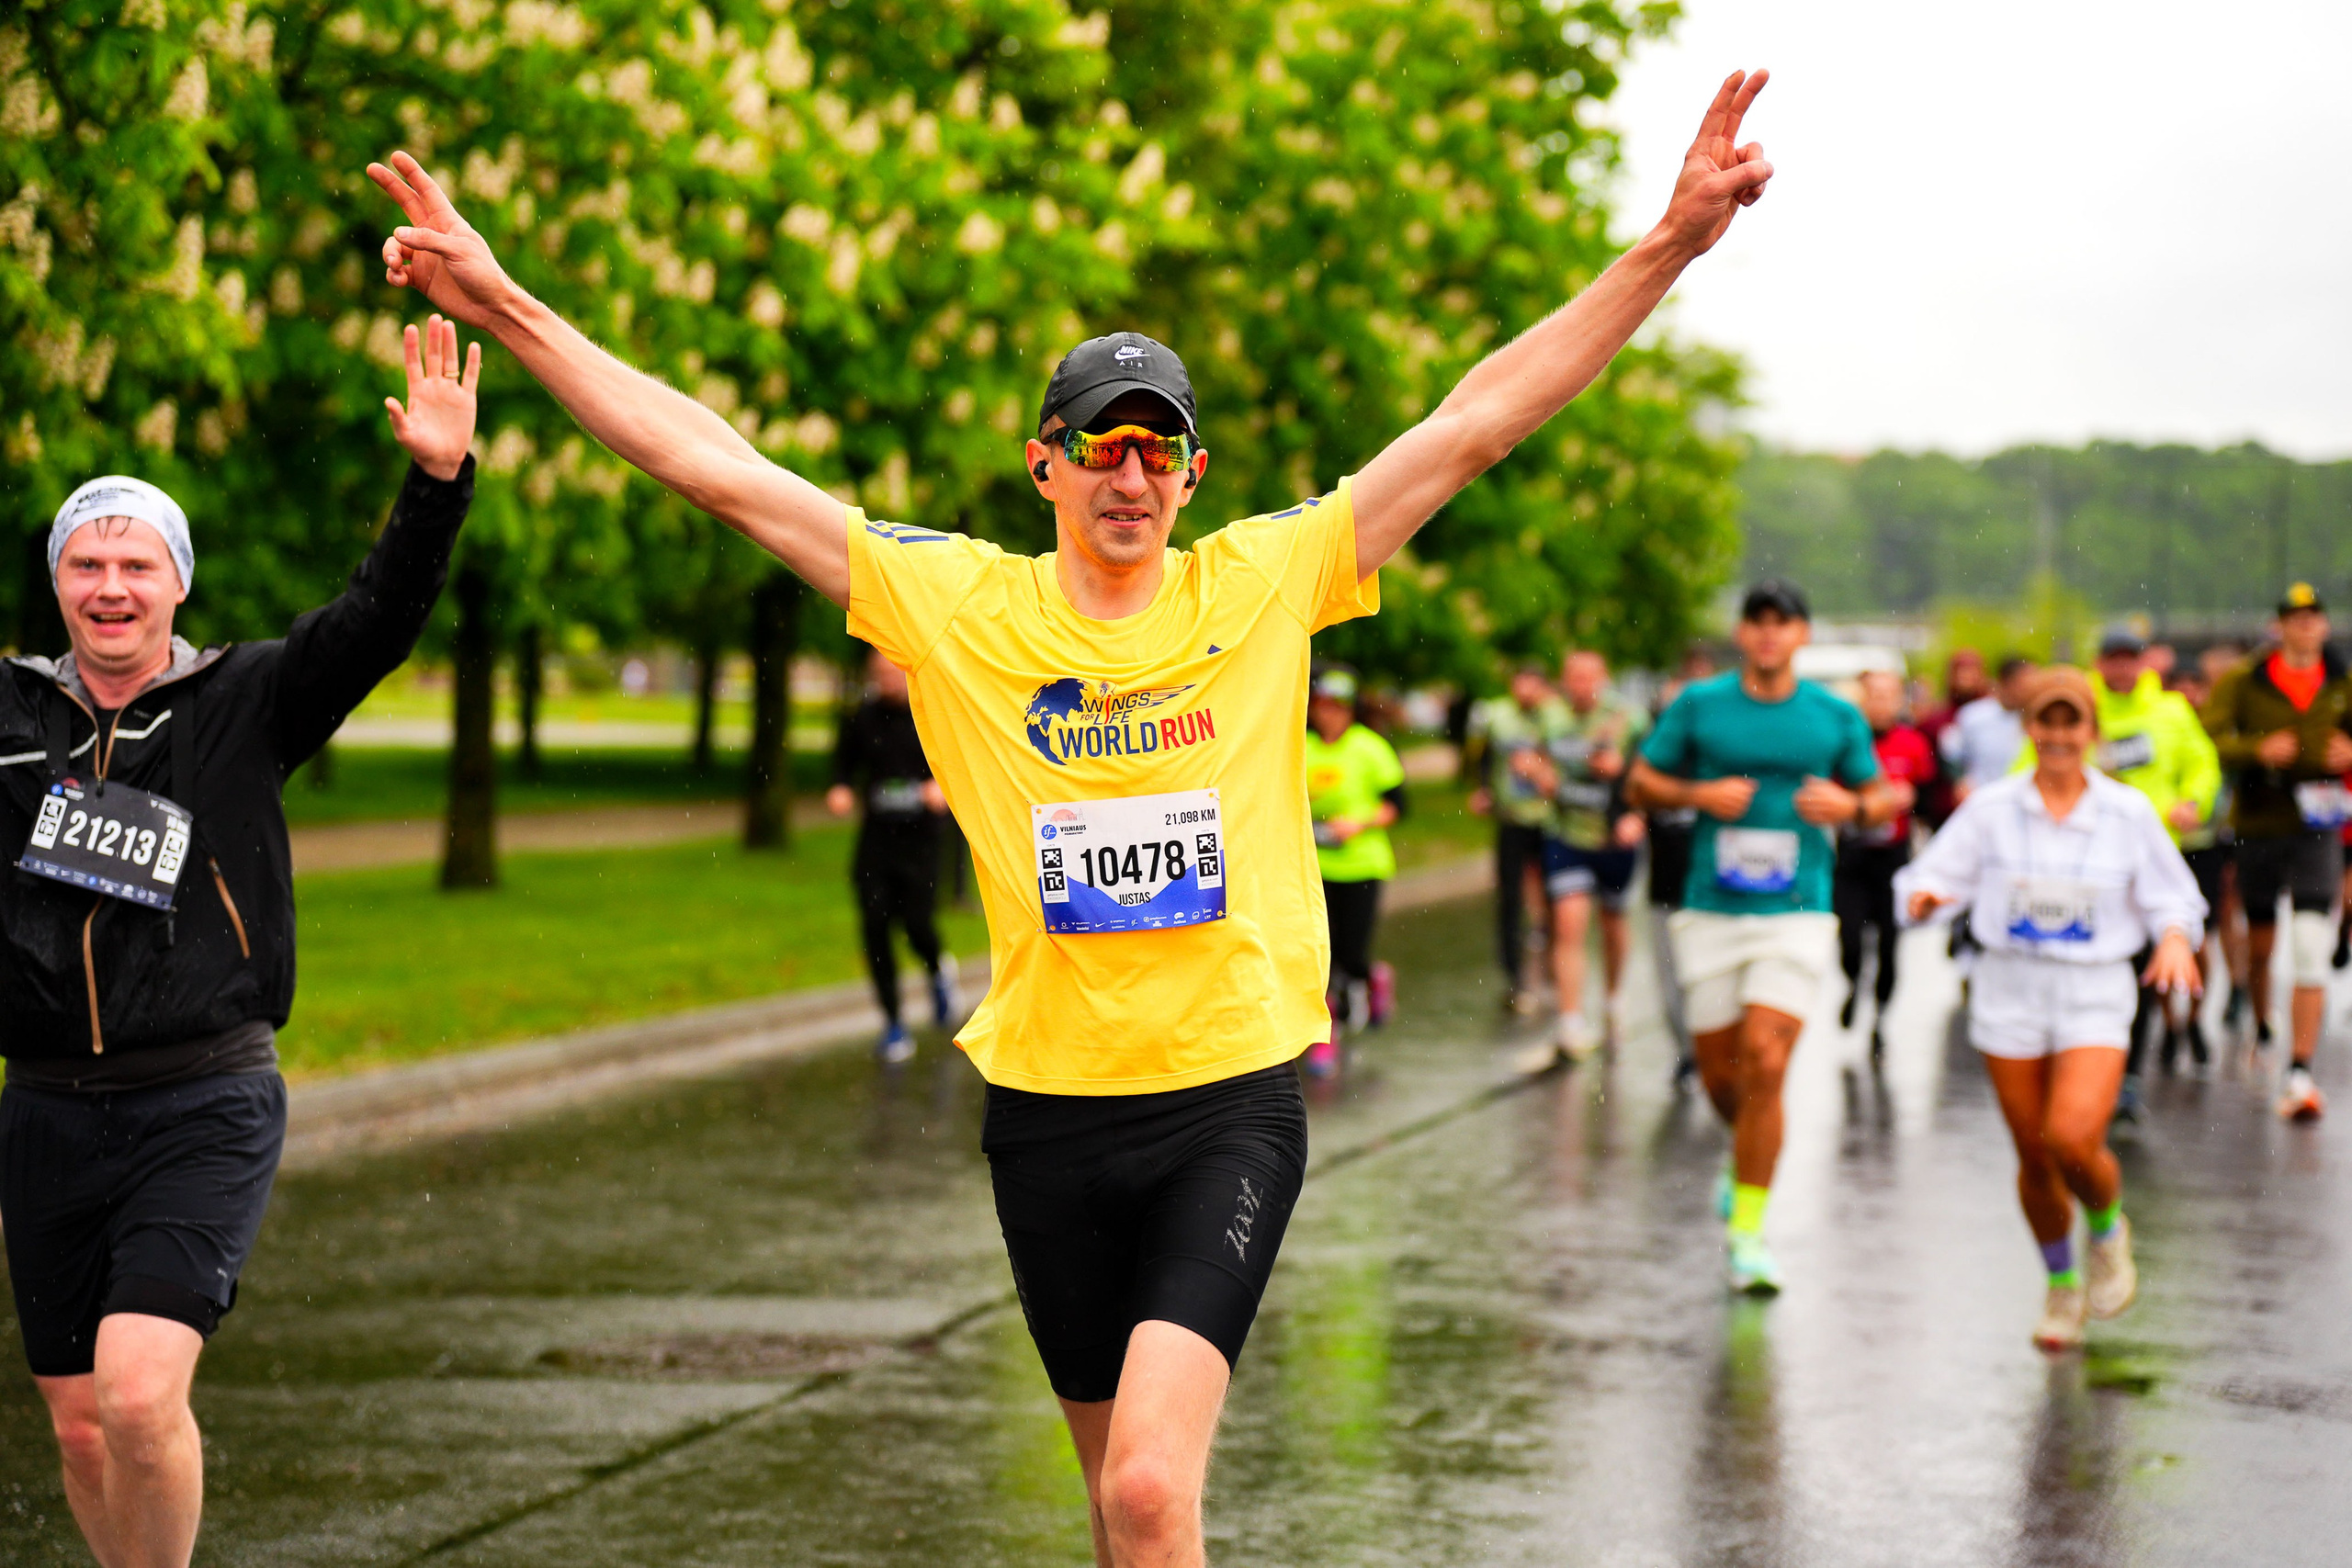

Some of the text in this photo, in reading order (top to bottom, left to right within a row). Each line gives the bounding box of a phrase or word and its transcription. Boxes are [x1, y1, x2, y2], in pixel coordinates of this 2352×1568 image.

[1119, 345, 1144, 355] NIKE
[1119, 360, 1143, 368] AIR
[1080, 709, 1133, 726] FOR LIFE
[1165, 808, 1216, 826] 21,098 KM
[1059, 824, 1087, 833] VILNIAUS
[62, 809, 158, 866] 21213
[1080, 840, 1186, 889] 10478
[1118, 892, 1151, 906] JUSTAS
